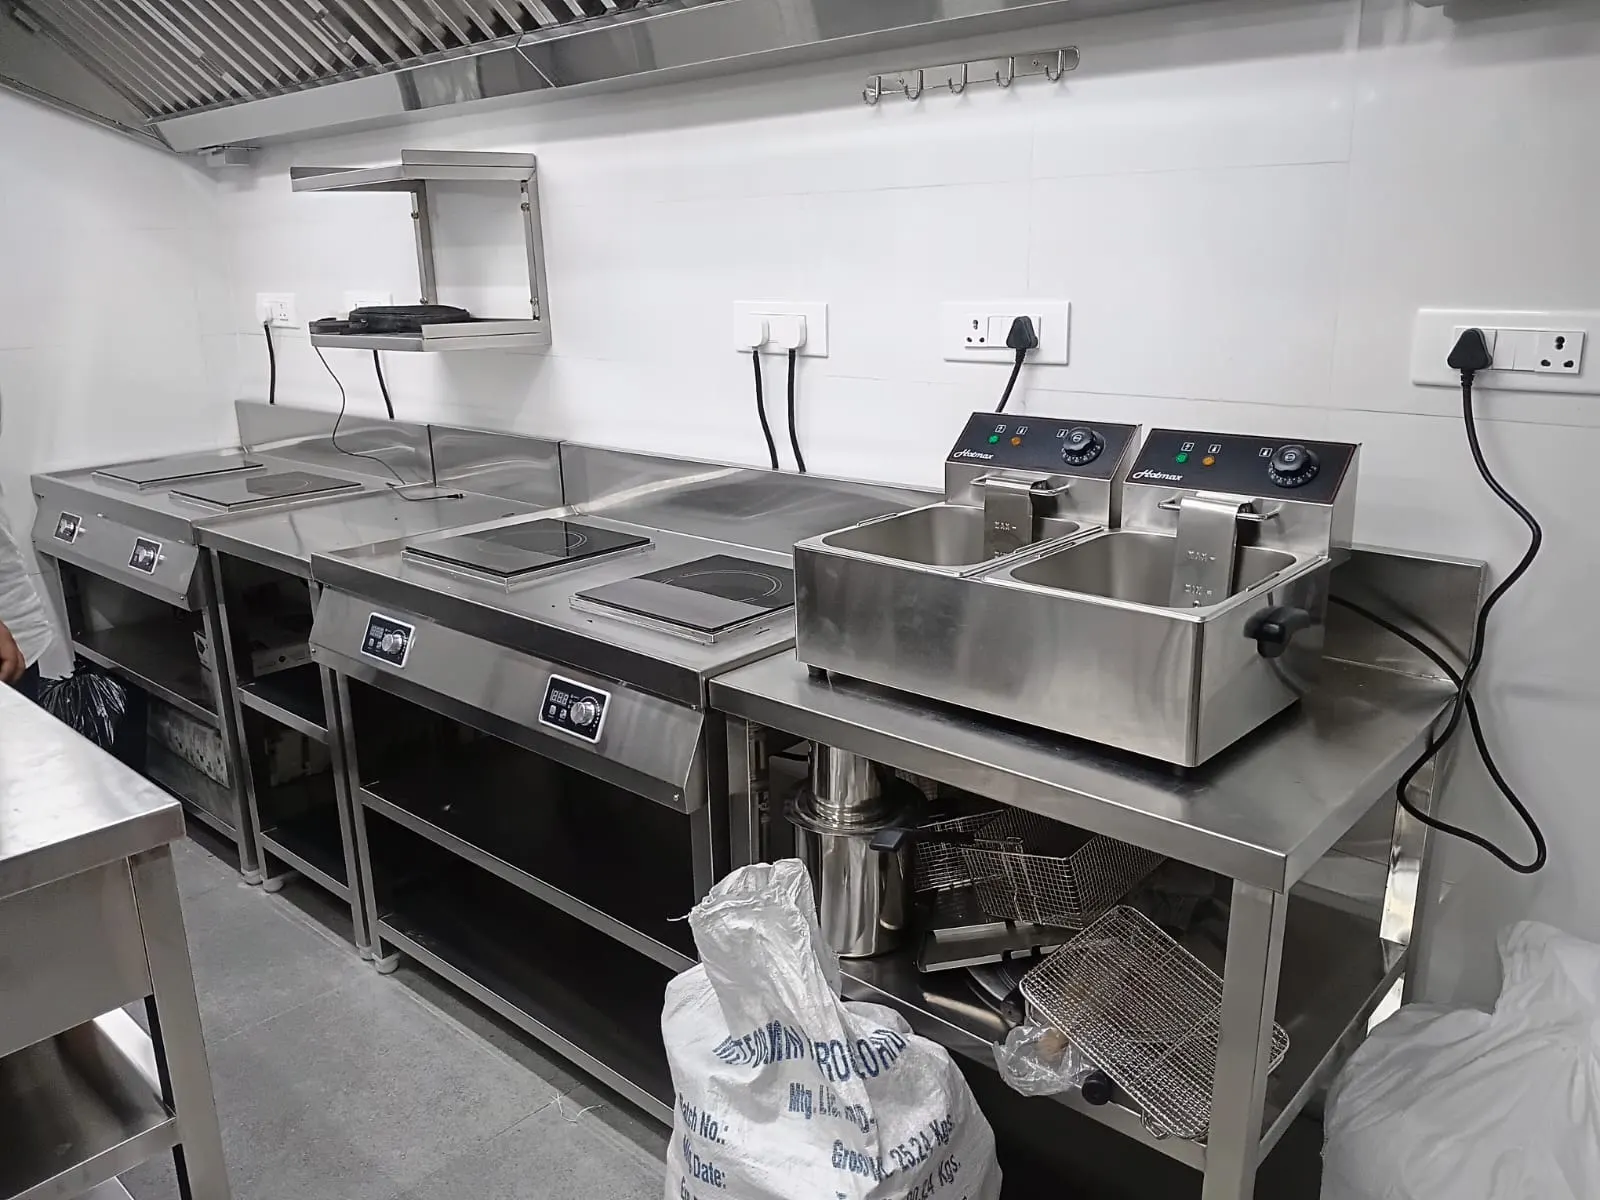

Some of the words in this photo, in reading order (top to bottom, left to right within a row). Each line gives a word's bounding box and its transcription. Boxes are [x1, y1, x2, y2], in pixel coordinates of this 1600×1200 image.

[953, 449, 994, 460] Hotmax
[1132, 469, 1184, 481] Hotmax
[693, 1153, 726, 1189] Date:
[938, 1154, 961, 1186] Kgs.
